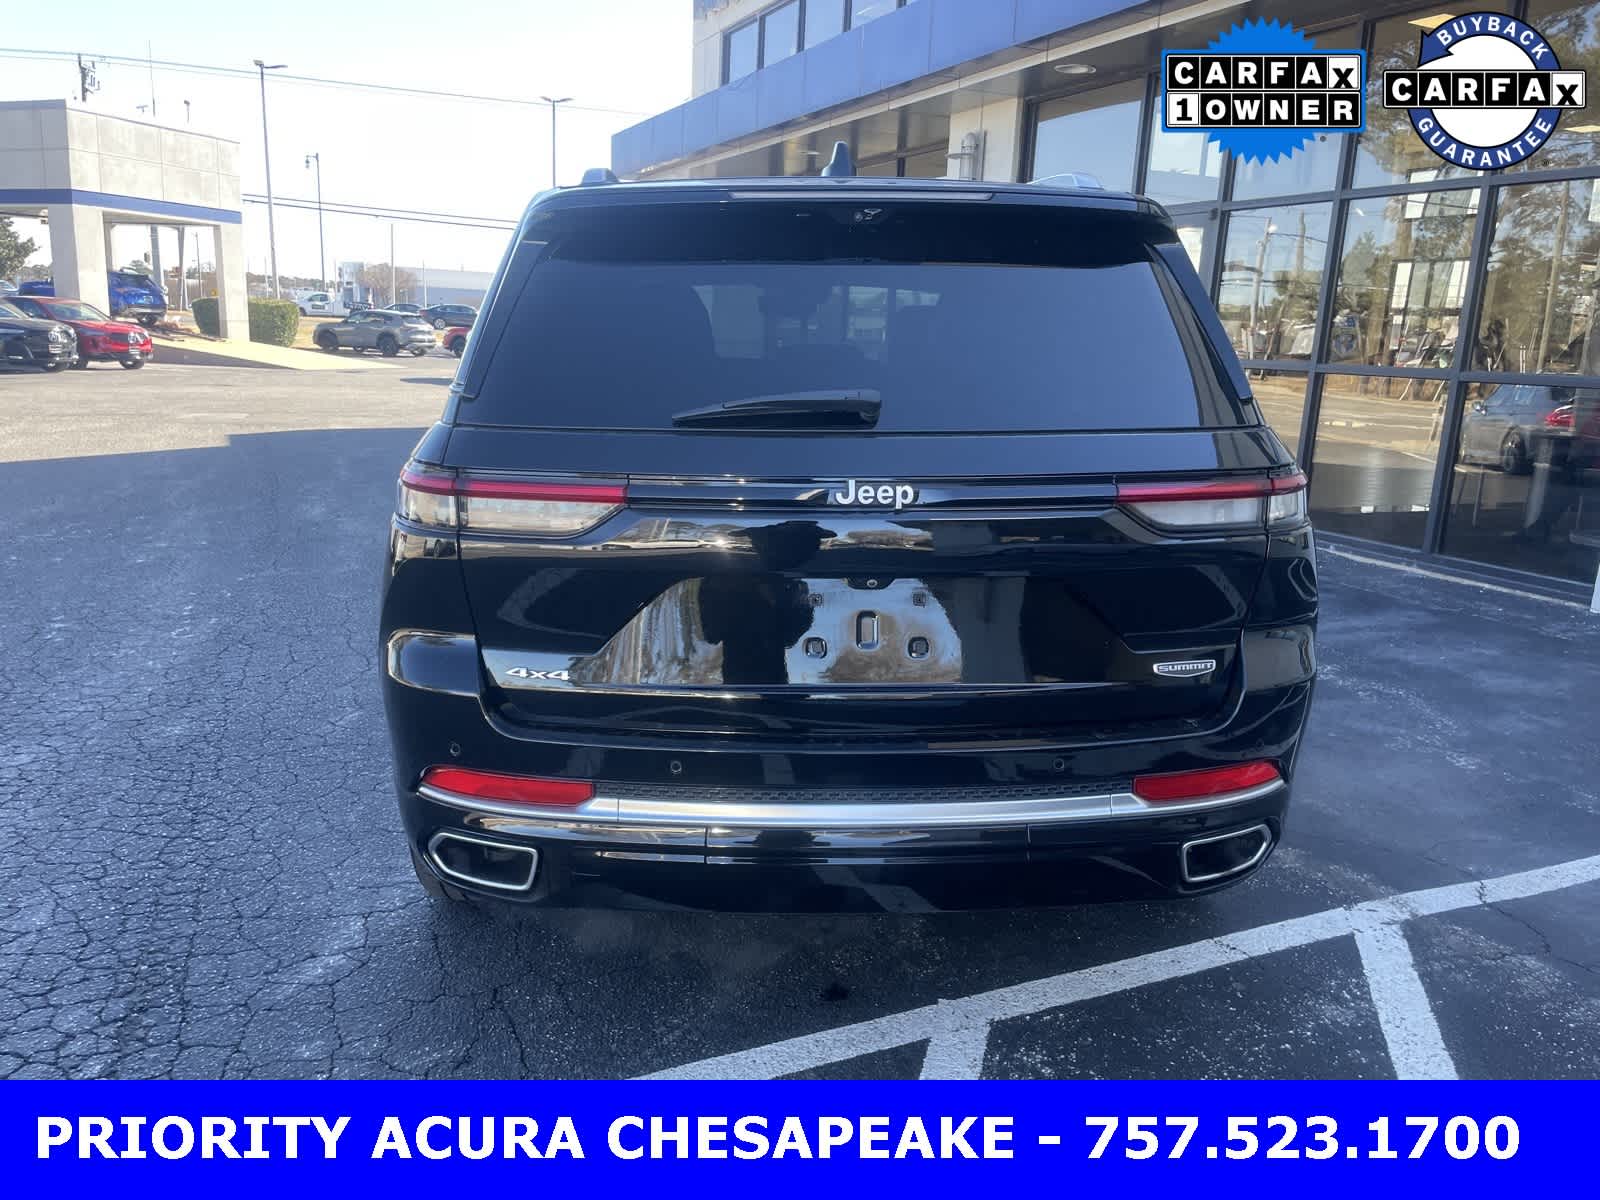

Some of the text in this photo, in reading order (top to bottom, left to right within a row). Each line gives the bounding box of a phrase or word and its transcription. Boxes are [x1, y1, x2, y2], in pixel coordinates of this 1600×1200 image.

[835, 479, 915, 510] Jeep
[504, 667, 570, 681] 4x4
[1158, 662, 1213, 672] SUMMIT
